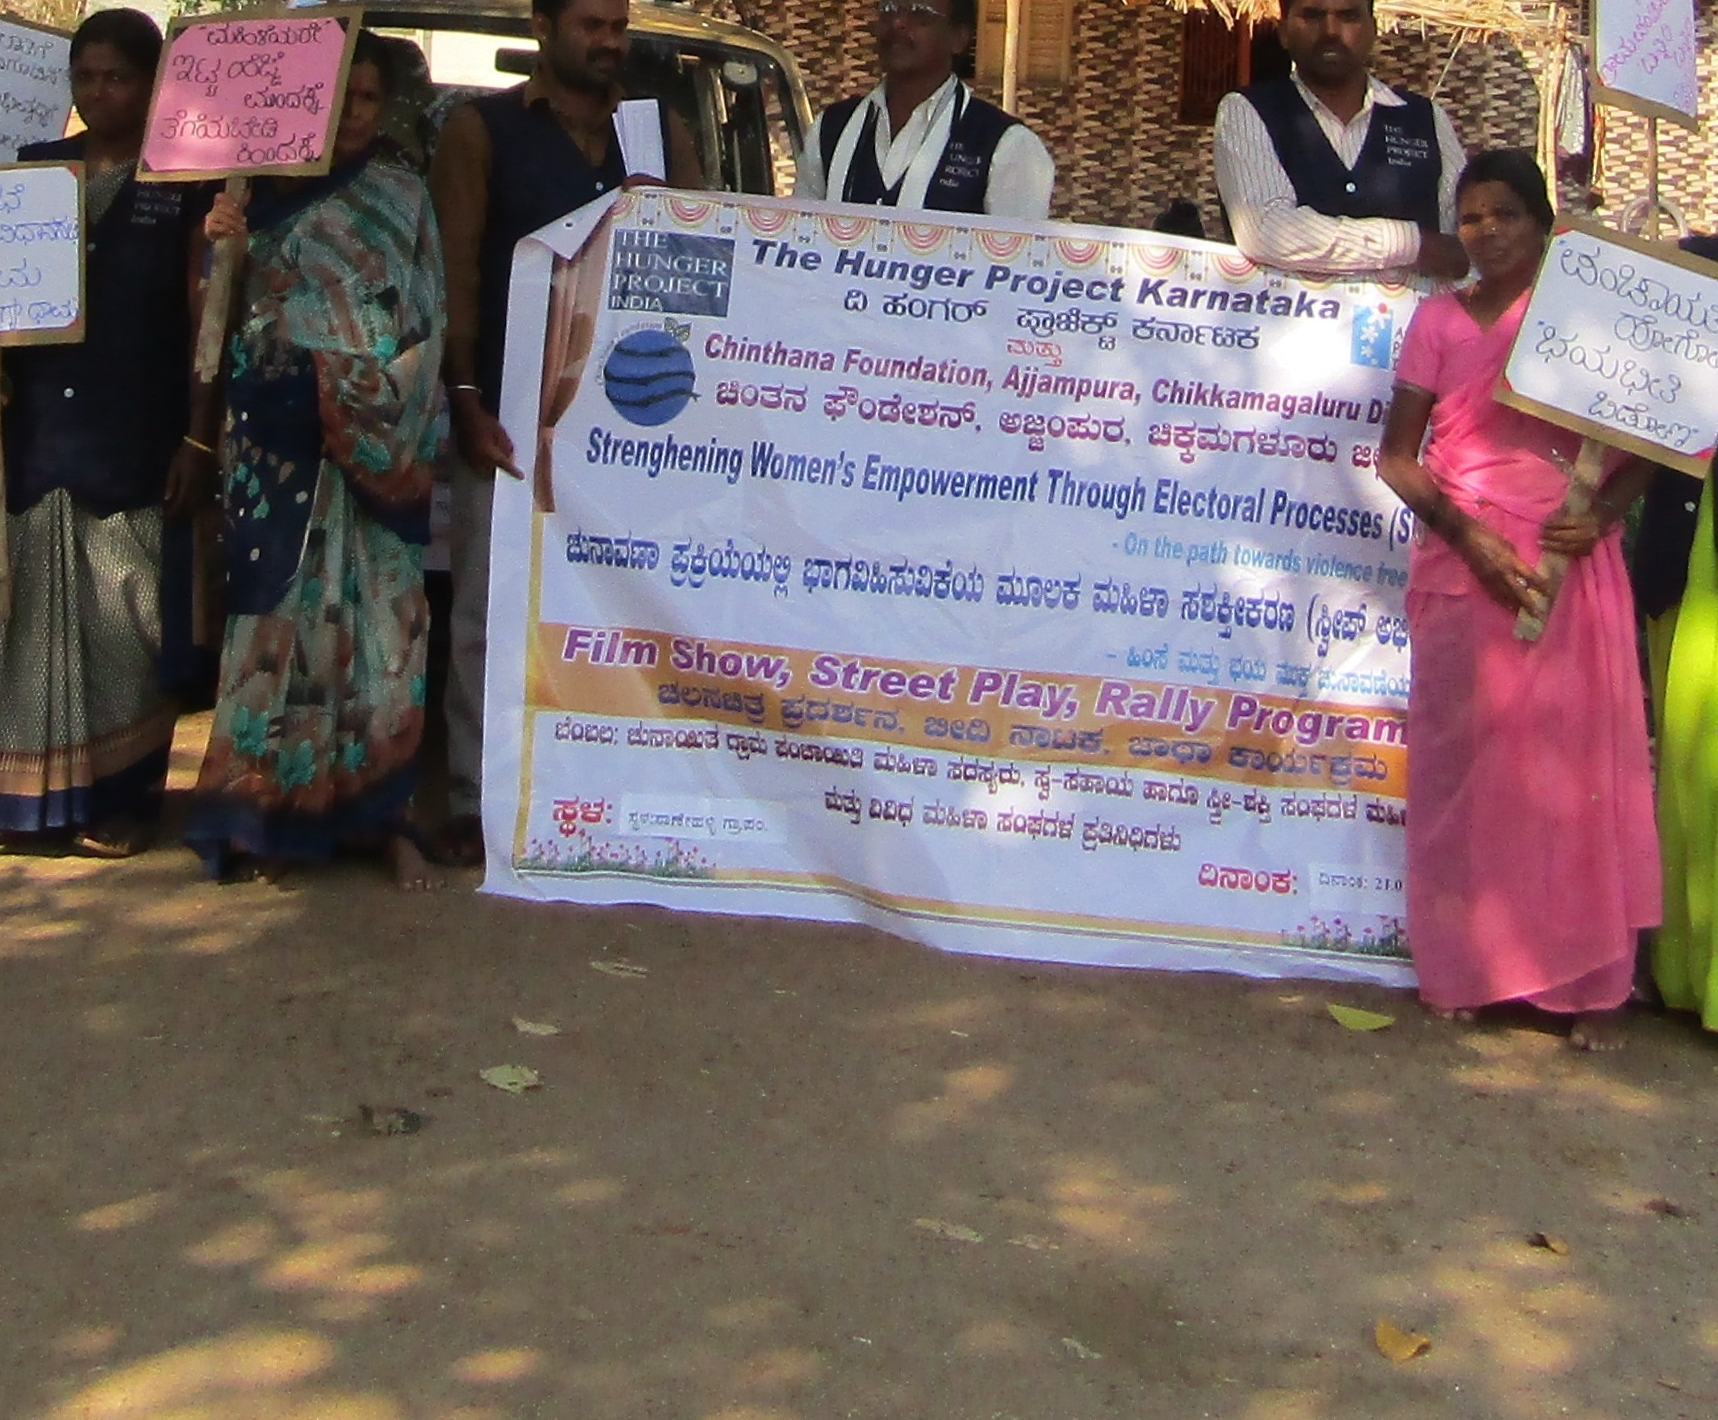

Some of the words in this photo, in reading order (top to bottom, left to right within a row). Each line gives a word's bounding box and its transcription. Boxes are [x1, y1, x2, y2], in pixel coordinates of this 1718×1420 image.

[617, 229, 668, 249] THE
[615, 251, 730, 277] HUNGER
[751, 239, 823, 272] The
[834, 249, 976, 291] Hunger
[984, 264, 1126, 304] Project
[1136, 278, 1342, 320] Karnataka
[611, 295, 664, 312] INDIA
[613, 273, 729, 298] PROJECT
[843, 289, 869, 313] ದಿ
[882, 292, 990, 323] ಹಂಗರ್
[1131, 317, 1261, 350] ಕರ್ನಾಟಕ
[1006, 337, 1065, 368] ಮತ್ತು
[704, 333, 835, 373] Chinthana
[843, 347, 993, 392] Foundation,
[1001, 364, 1143, 407] Ajjampura,
[1150, 379, 1362, 422] Chikkamagaluru
[716, 380, 808, 413] ಚಿಂತನ
[1147, 419, 1338, 465] ಚಿಕ್ಕಮಗಳೂರು
[586, 425, 743, 486] Strenghening
[748, 440, 857, 488] Women's
[861, 453, 1041, 504] Empowerment
[1047, 469, 1145, 521] Through
[1153, 478, 1266, 525] Electoral
[1269, 491, 1384, 541] Processes
[565, 528, 660, 571] ಚುನಾವಣಾ
[996, 565, 1083, 611] ಮೂಲಕ
[1091, 575, 1171, 620] ಮಹಿಳಾ
[1124, 531, 1149, 557] On
[1154, 534, 1183, 560] the
[1186, 540, 1228, 567] path
[1233, 543, 1302, 573] towards
[1306, 552, 1374, 582] violence
[562, 627, 659, 668] Film
[669, 638, 794, 690] Show,
[808, 652, 958, 703] Street
[968, 668, 1081, 719] Play,
[1093, 678, 1218, 734] Rally
[924, 715, 992, 743] ಬೀದಿ
[873, 745, 939, 777] ಮಹಿಳಾ
[922, 799, 989, 830] ಮಹಿಳಾ
